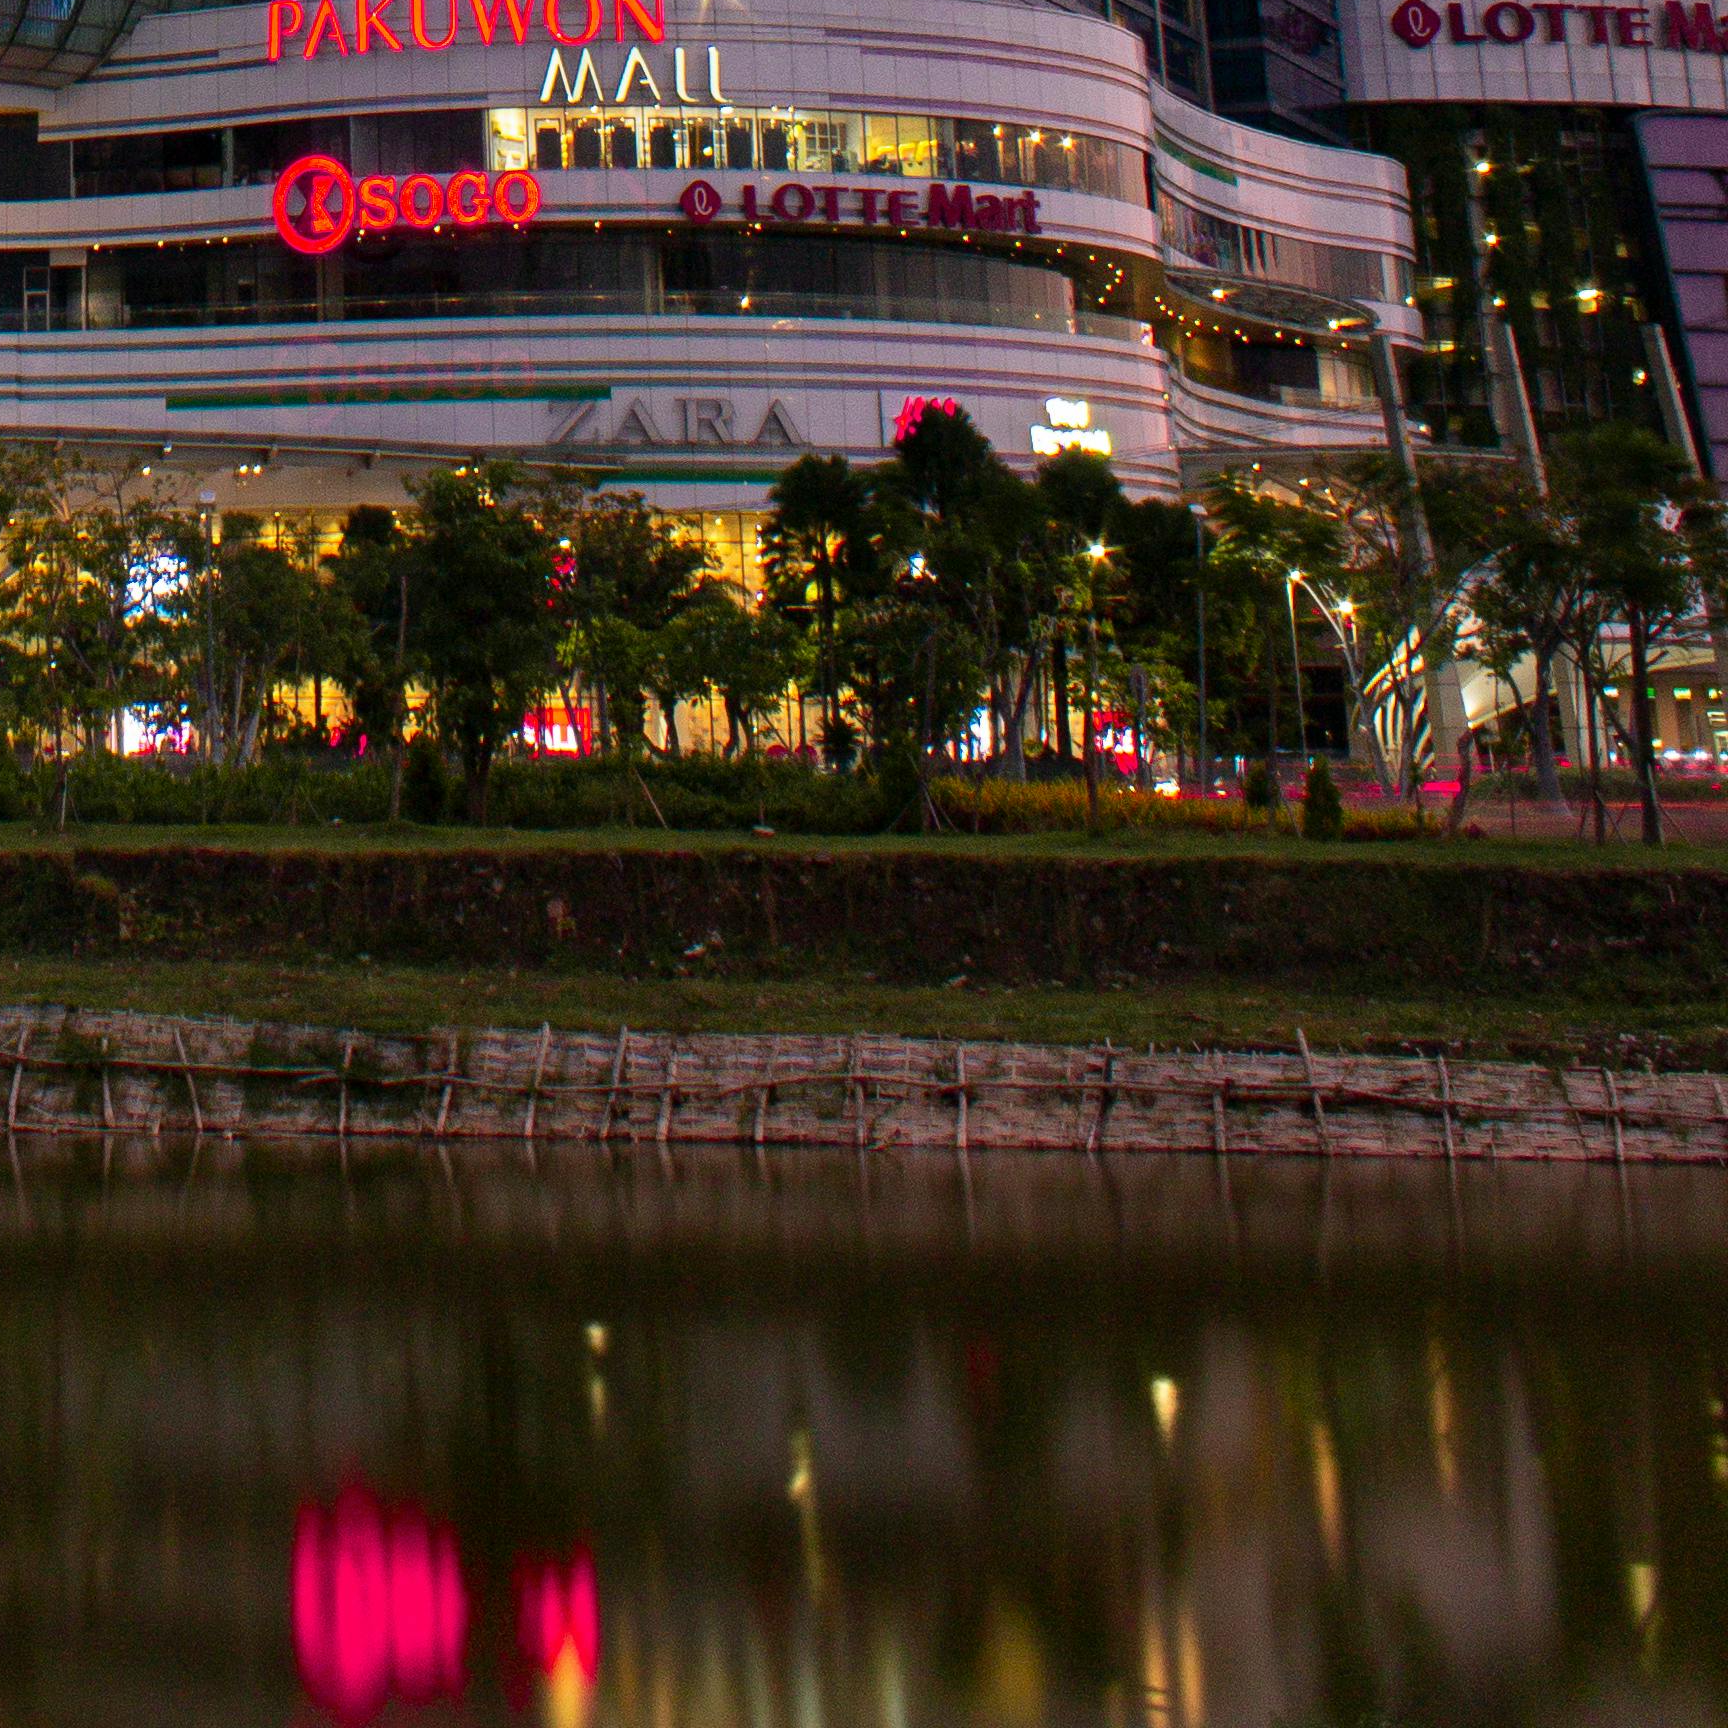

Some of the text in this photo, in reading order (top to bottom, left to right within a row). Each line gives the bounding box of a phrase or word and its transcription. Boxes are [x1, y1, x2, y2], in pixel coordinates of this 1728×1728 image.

[1448, 1, 1652, 46] LOTTE
[539, 46, 729, 103] MALL
[357, 169, 541, 231] SOGO
[741, 182, 1042, 234] LOTTE Mart
[545, 396, 812, 445] ZARA
